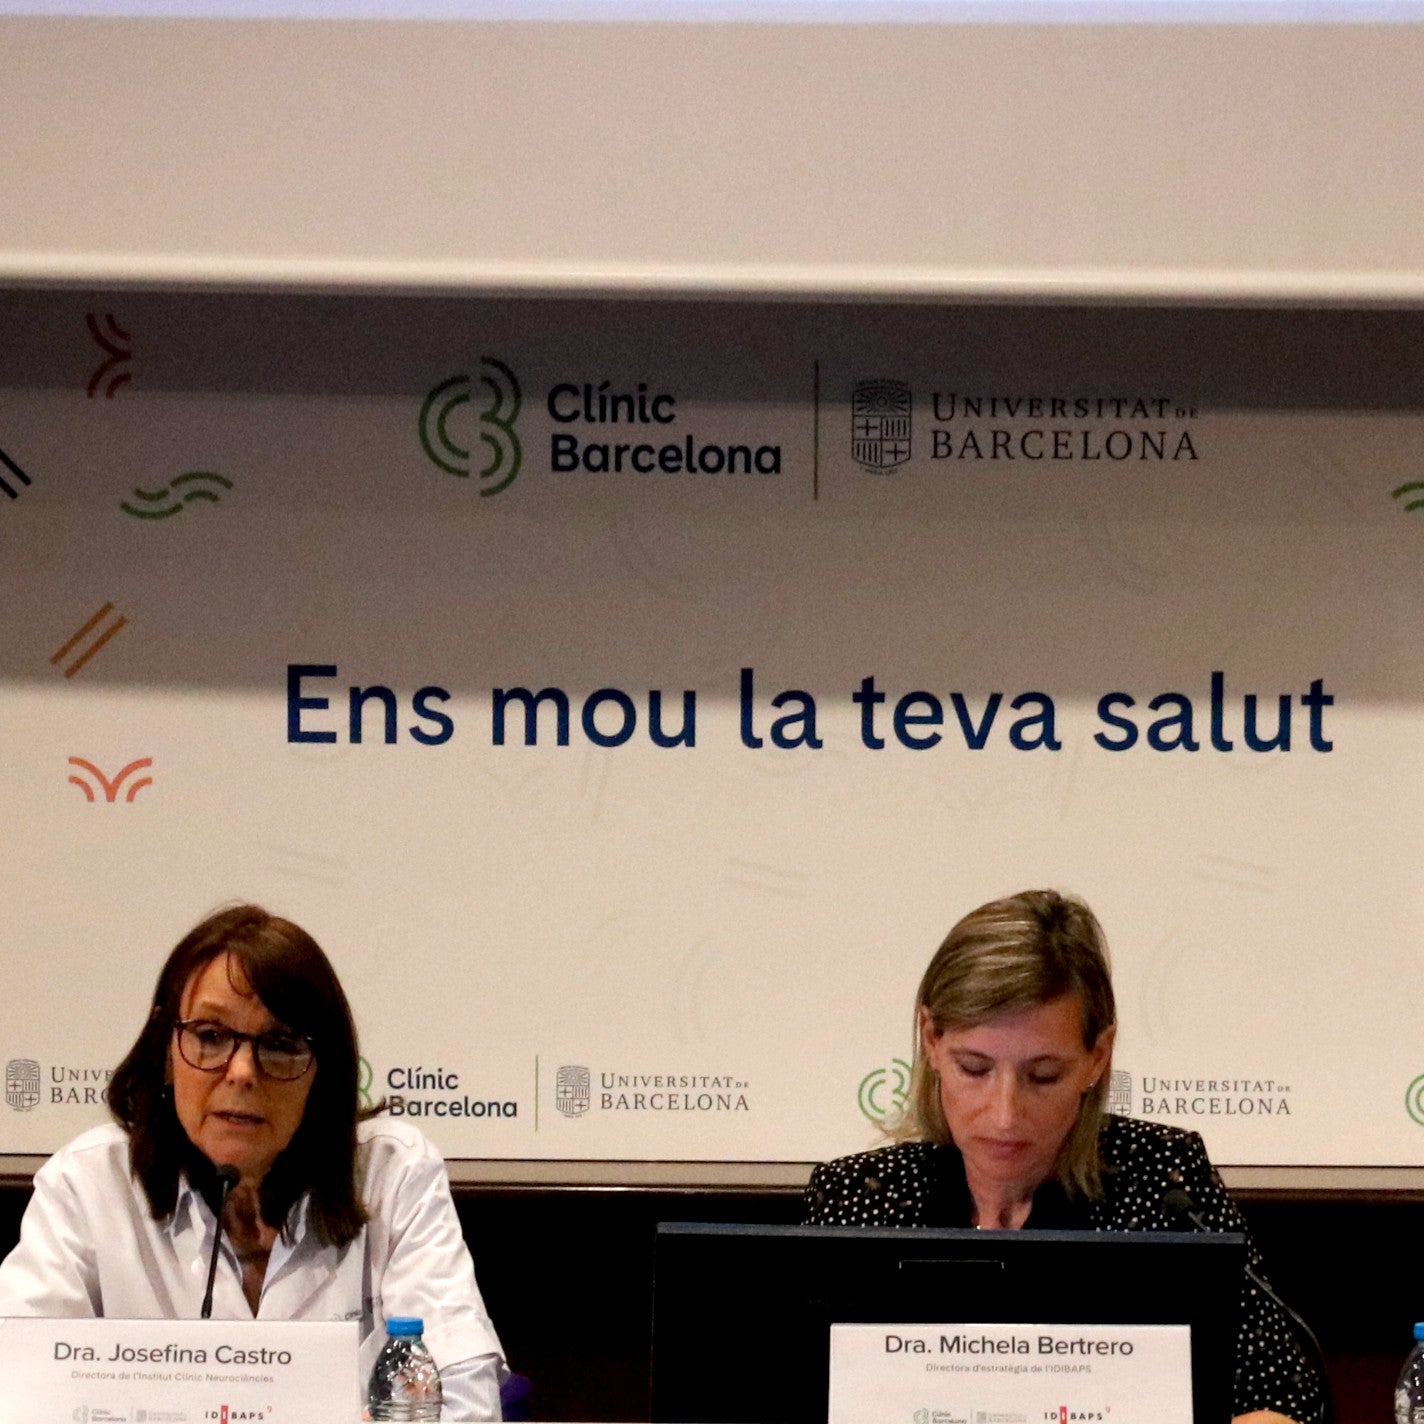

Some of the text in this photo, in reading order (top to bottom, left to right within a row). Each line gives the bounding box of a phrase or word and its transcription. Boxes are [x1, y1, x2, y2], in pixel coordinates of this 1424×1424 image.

[548, 381, 675, 424] Clínic
[932, 392, 1170, 424] UNIVERSITAT
[551, 433, 781, 474] Barcelona
[931, 429, 1198, 460] BARCELONA
[287, 665, 1334, 753] Ens mou la teva salut
[387, 1067, 458, 1090] Clínic
[601, 1073, 733, 1089] UNIVERSITAT
[1143, 1077, 1274, 1094] UNIVERSITAT
[388, 1096, 517, 1118] Barcelona
[601, 1093, 749, 1111] BARCELONA
[1142, 1097, 1290, 1115] BARCELONA
[54, 1342, 292, 1365] Dra. Josefina Castro
[886, 1335, 1133, 1355] Dra. Michela Bertrero
[203, 1409, 264, 1422] IDIBAPS
[1043, 1410, 1103, 1423] IDIBAPS
